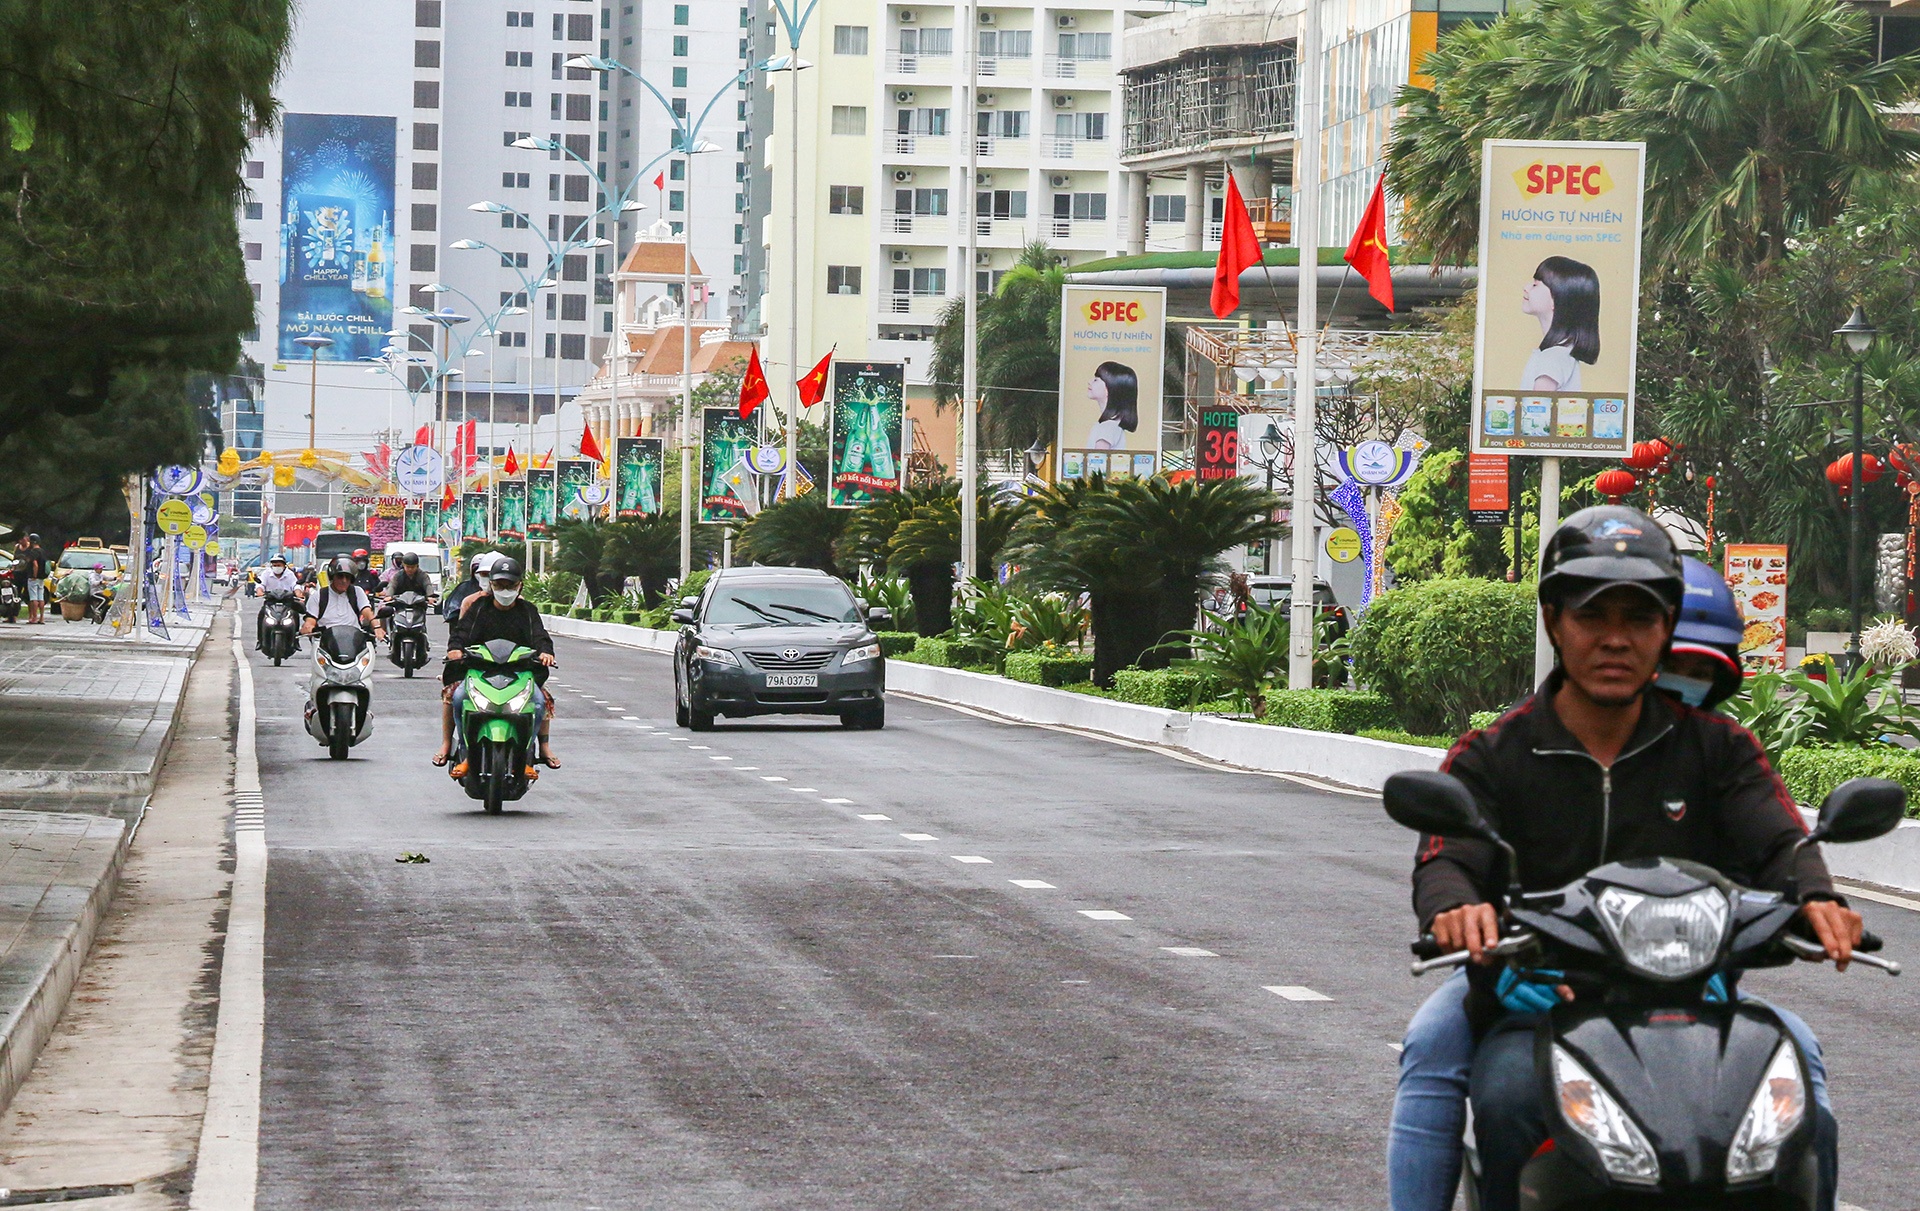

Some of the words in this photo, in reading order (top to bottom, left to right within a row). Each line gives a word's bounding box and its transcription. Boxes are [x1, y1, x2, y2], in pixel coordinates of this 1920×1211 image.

[1526, 164, 1602, 195] SPEC
[1501, 208, 1555, 222] HƯƠNG
[1559, 210, 1576, 225] TỰ
[1580, 209, 1623, 224] NHIÊN
[1525, 233, 1542, 241] em
[1596, 233, 1622, 243] SPEC
[1090, 301, 1138, 322] SPEC
[346, 315, 375, 323] CHILL
[347, 325, 385, 335] CHILL
[1073, 330, 1108, 339] HƯƠNG
[1111, 331, 1122, 342] TỰ
[1124, 331, 1153, 341] NHIÊN
[1600, 404, 1618, 413] CEO
